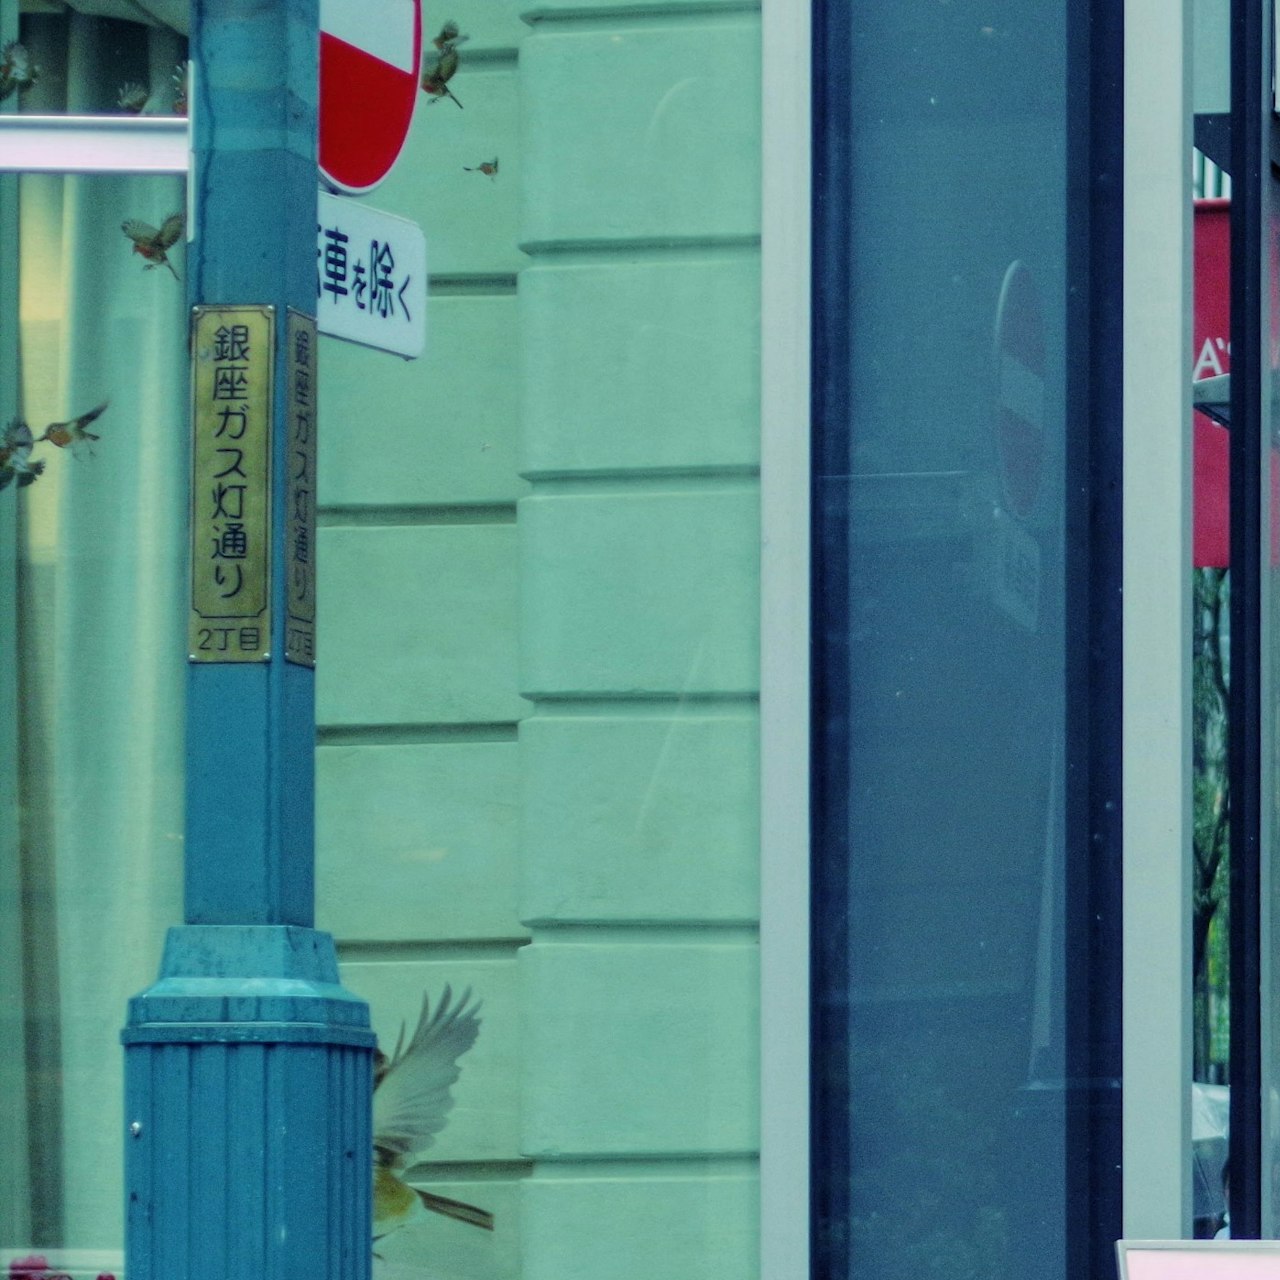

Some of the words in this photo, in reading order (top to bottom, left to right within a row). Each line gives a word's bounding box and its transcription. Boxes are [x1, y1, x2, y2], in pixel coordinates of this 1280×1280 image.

[318, 225, 411, 323] 車を除く
[211, 325, 250, 599] 銀座ガス灯通り
[197, 627, 261, 652] 2丁目
